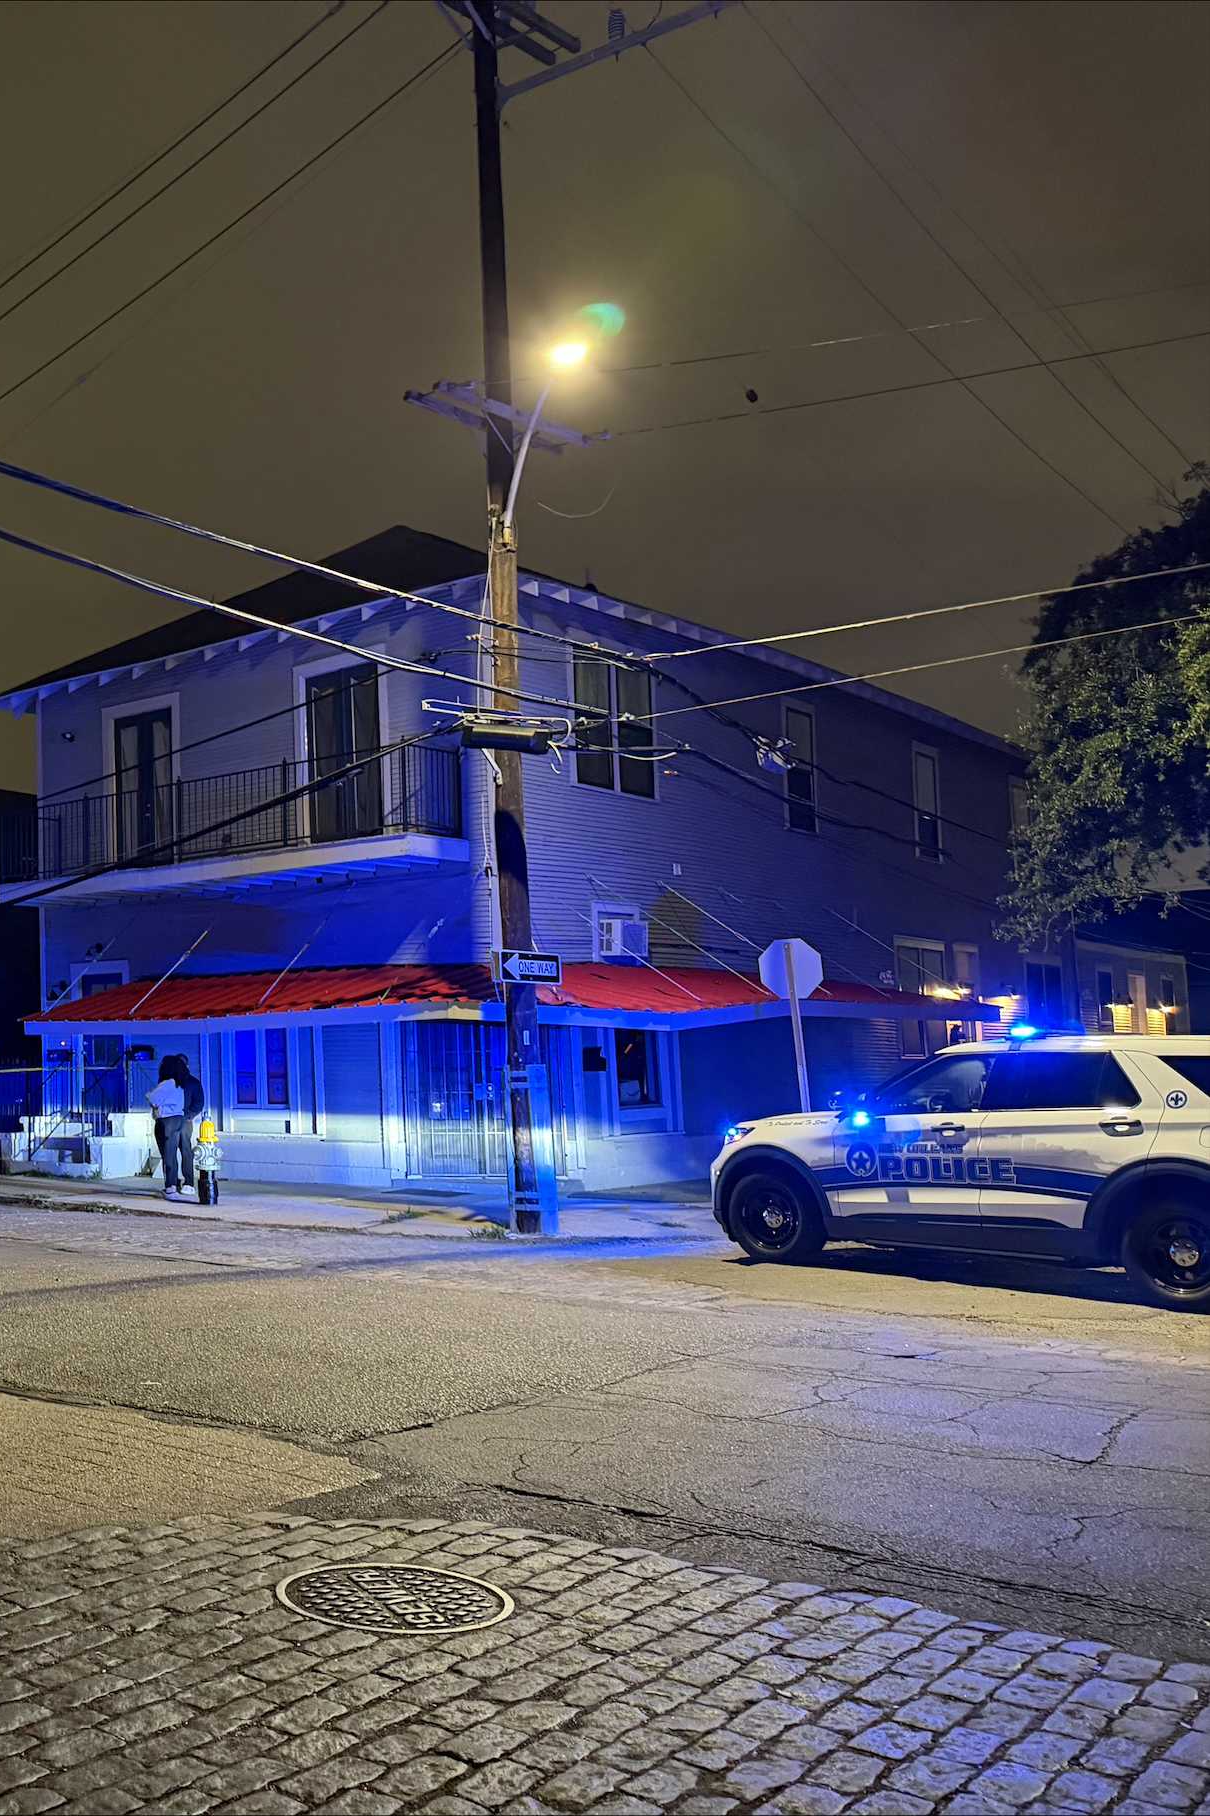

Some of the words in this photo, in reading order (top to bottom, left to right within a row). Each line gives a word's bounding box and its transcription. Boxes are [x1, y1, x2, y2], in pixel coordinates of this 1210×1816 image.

[518, 960, 535, 973] ONE
[536, 961, 555, 975] WAY
[878, 1154, 1017, 1185] POLICE
[351, 1571, 445, 1624] SEWER
